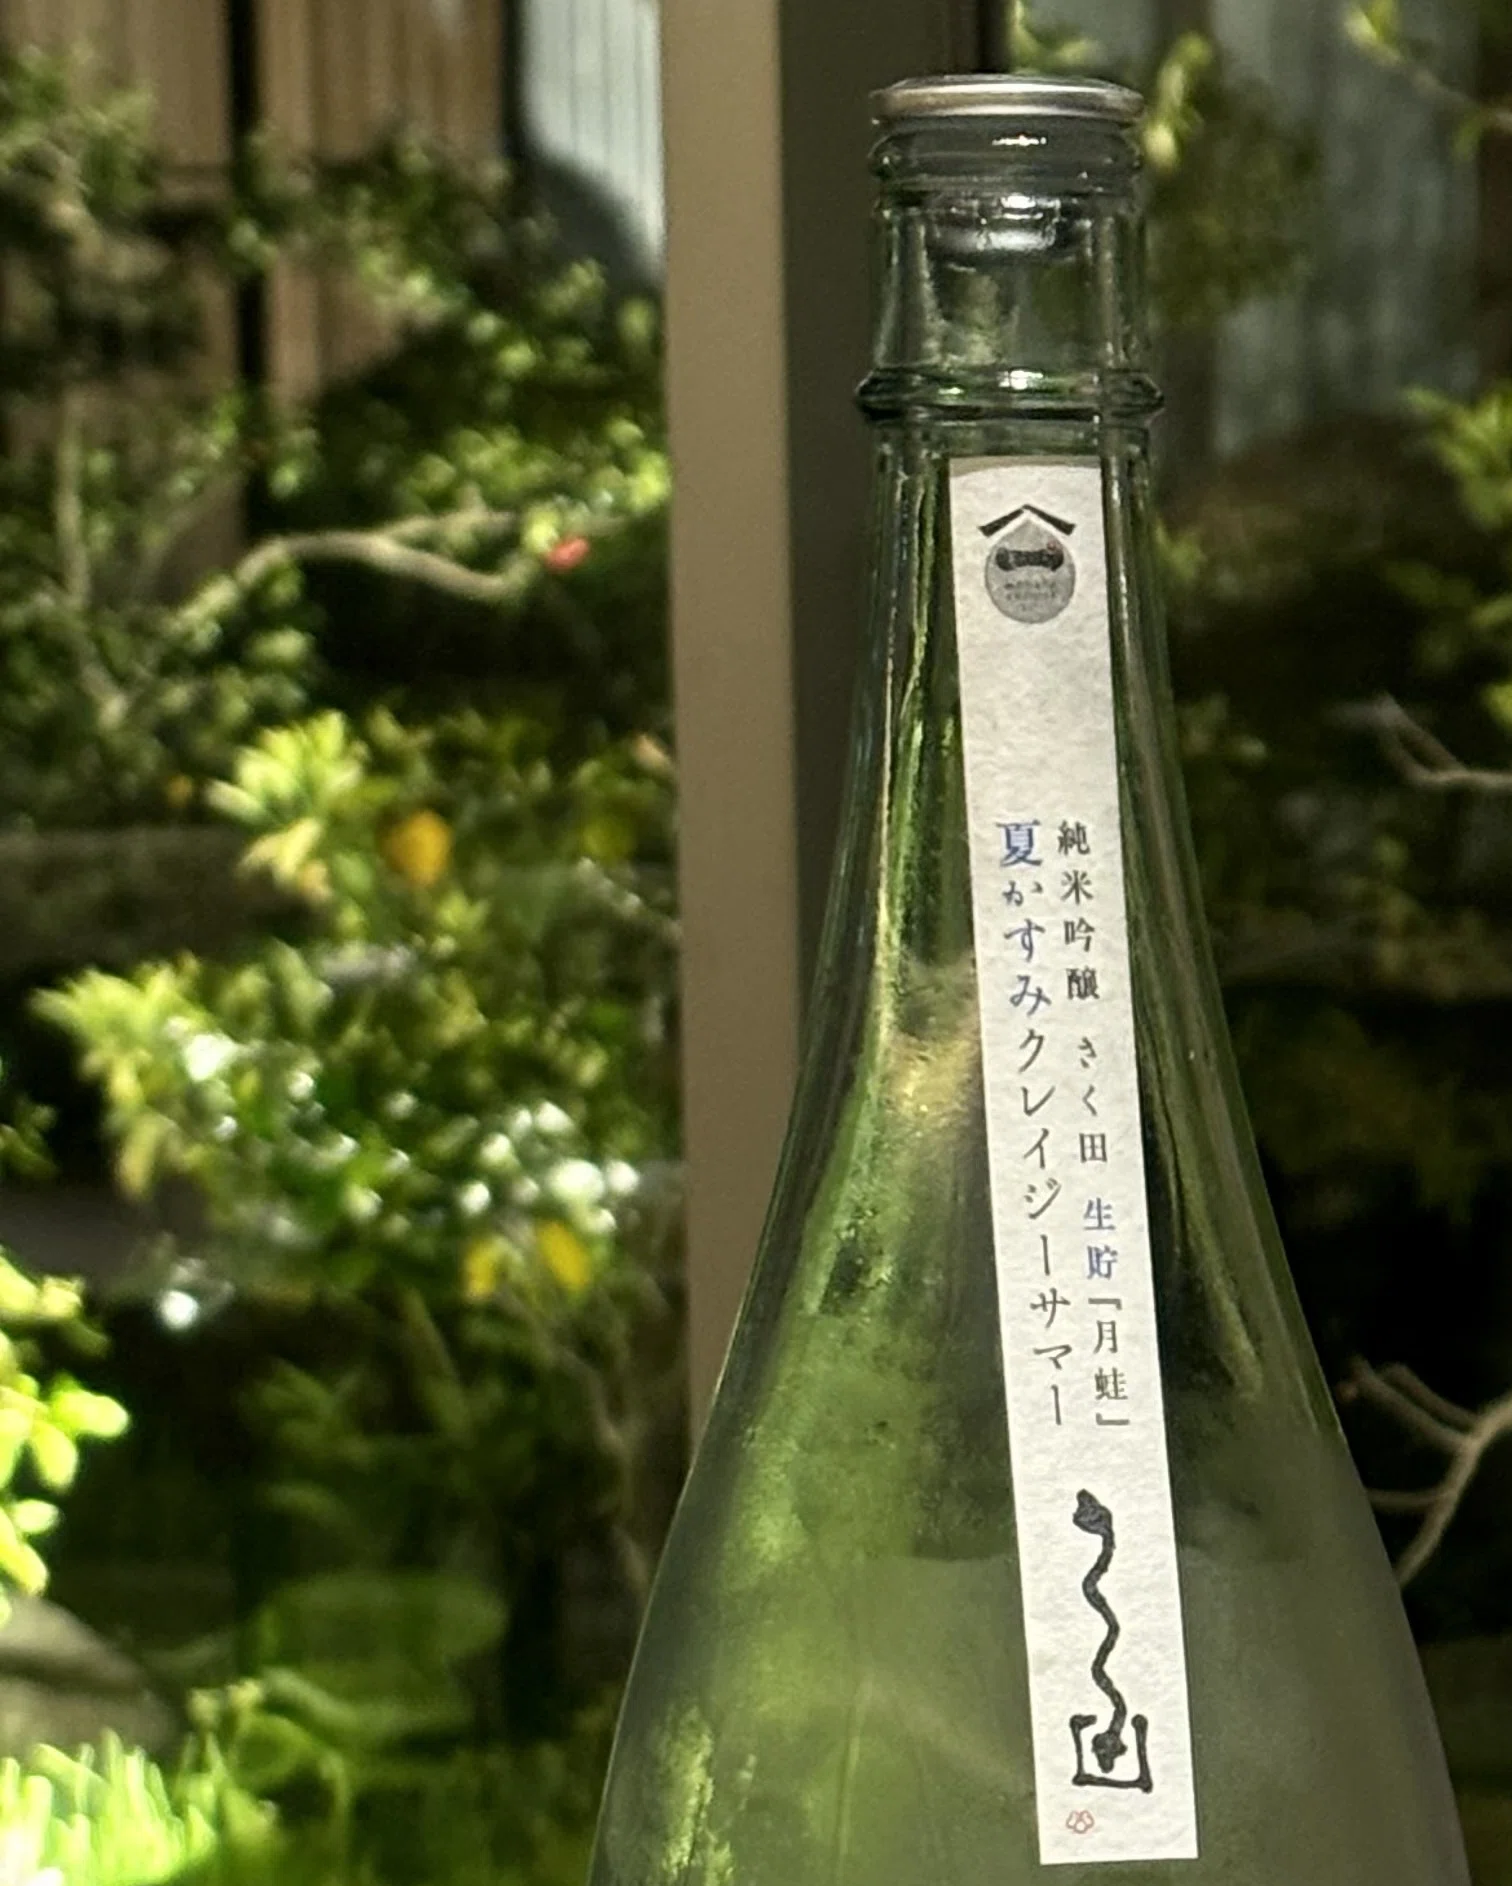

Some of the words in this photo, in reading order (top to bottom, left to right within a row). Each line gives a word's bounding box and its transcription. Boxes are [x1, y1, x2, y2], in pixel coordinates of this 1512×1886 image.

[1058, 821, 1100, 1000] 純米吟醸
[996, 820, 1073, 1426] 夏かすみクレイジーサマー
[1078, 1037, 1108, 1163] さく田
